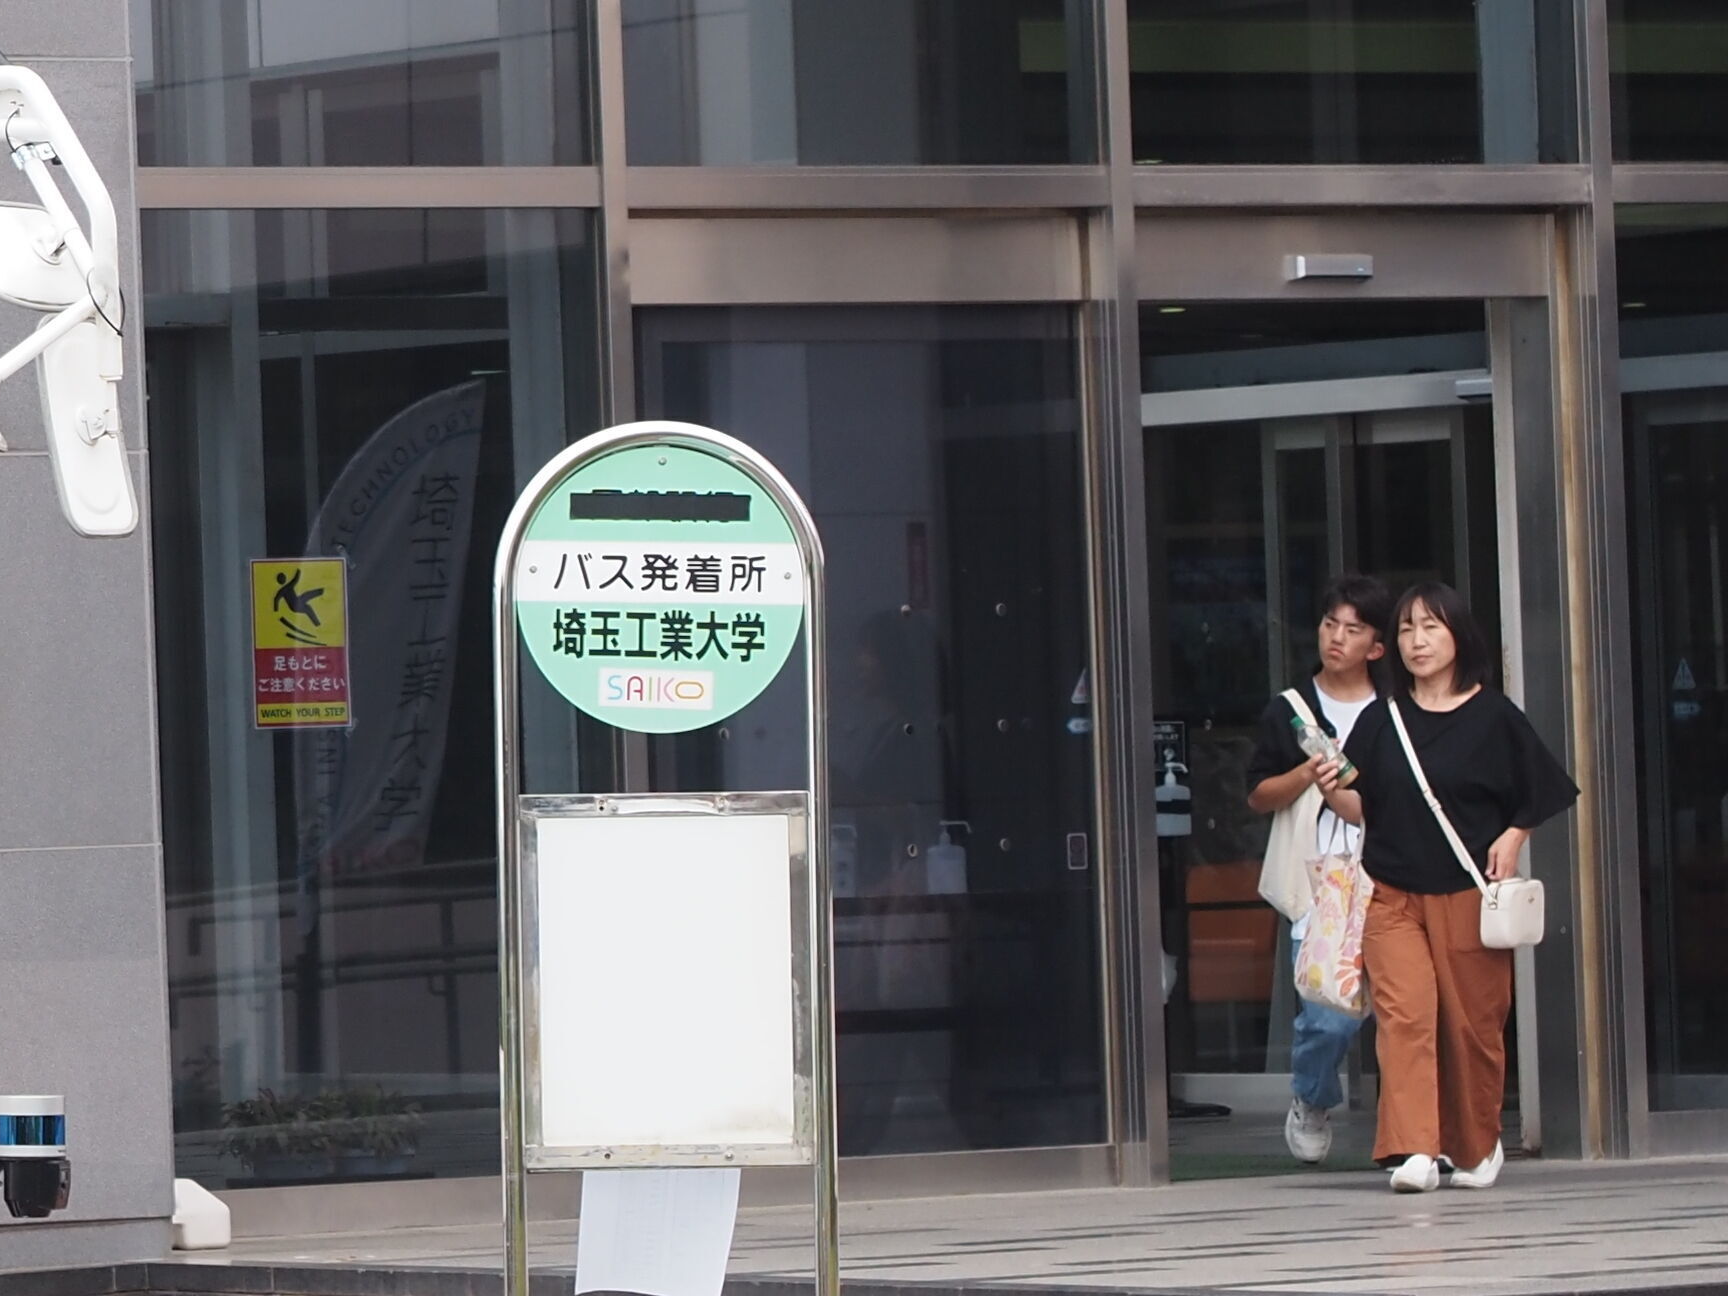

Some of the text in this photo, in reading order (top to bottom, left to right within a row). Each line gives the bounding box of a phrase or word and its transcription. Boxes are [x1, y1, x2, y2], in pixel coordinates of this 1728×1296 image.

[553, 552, 767, 593] バス発着所
[552, 608, 766, 662] 埼玉工業大学
[273, 656, 327, 671] 足もとに
[258, 677, 345, 693] ご注意ください
[607, 675, 704, 702] SAIKO
[260, 706, 346, 719] WATCH YOUR STEP
